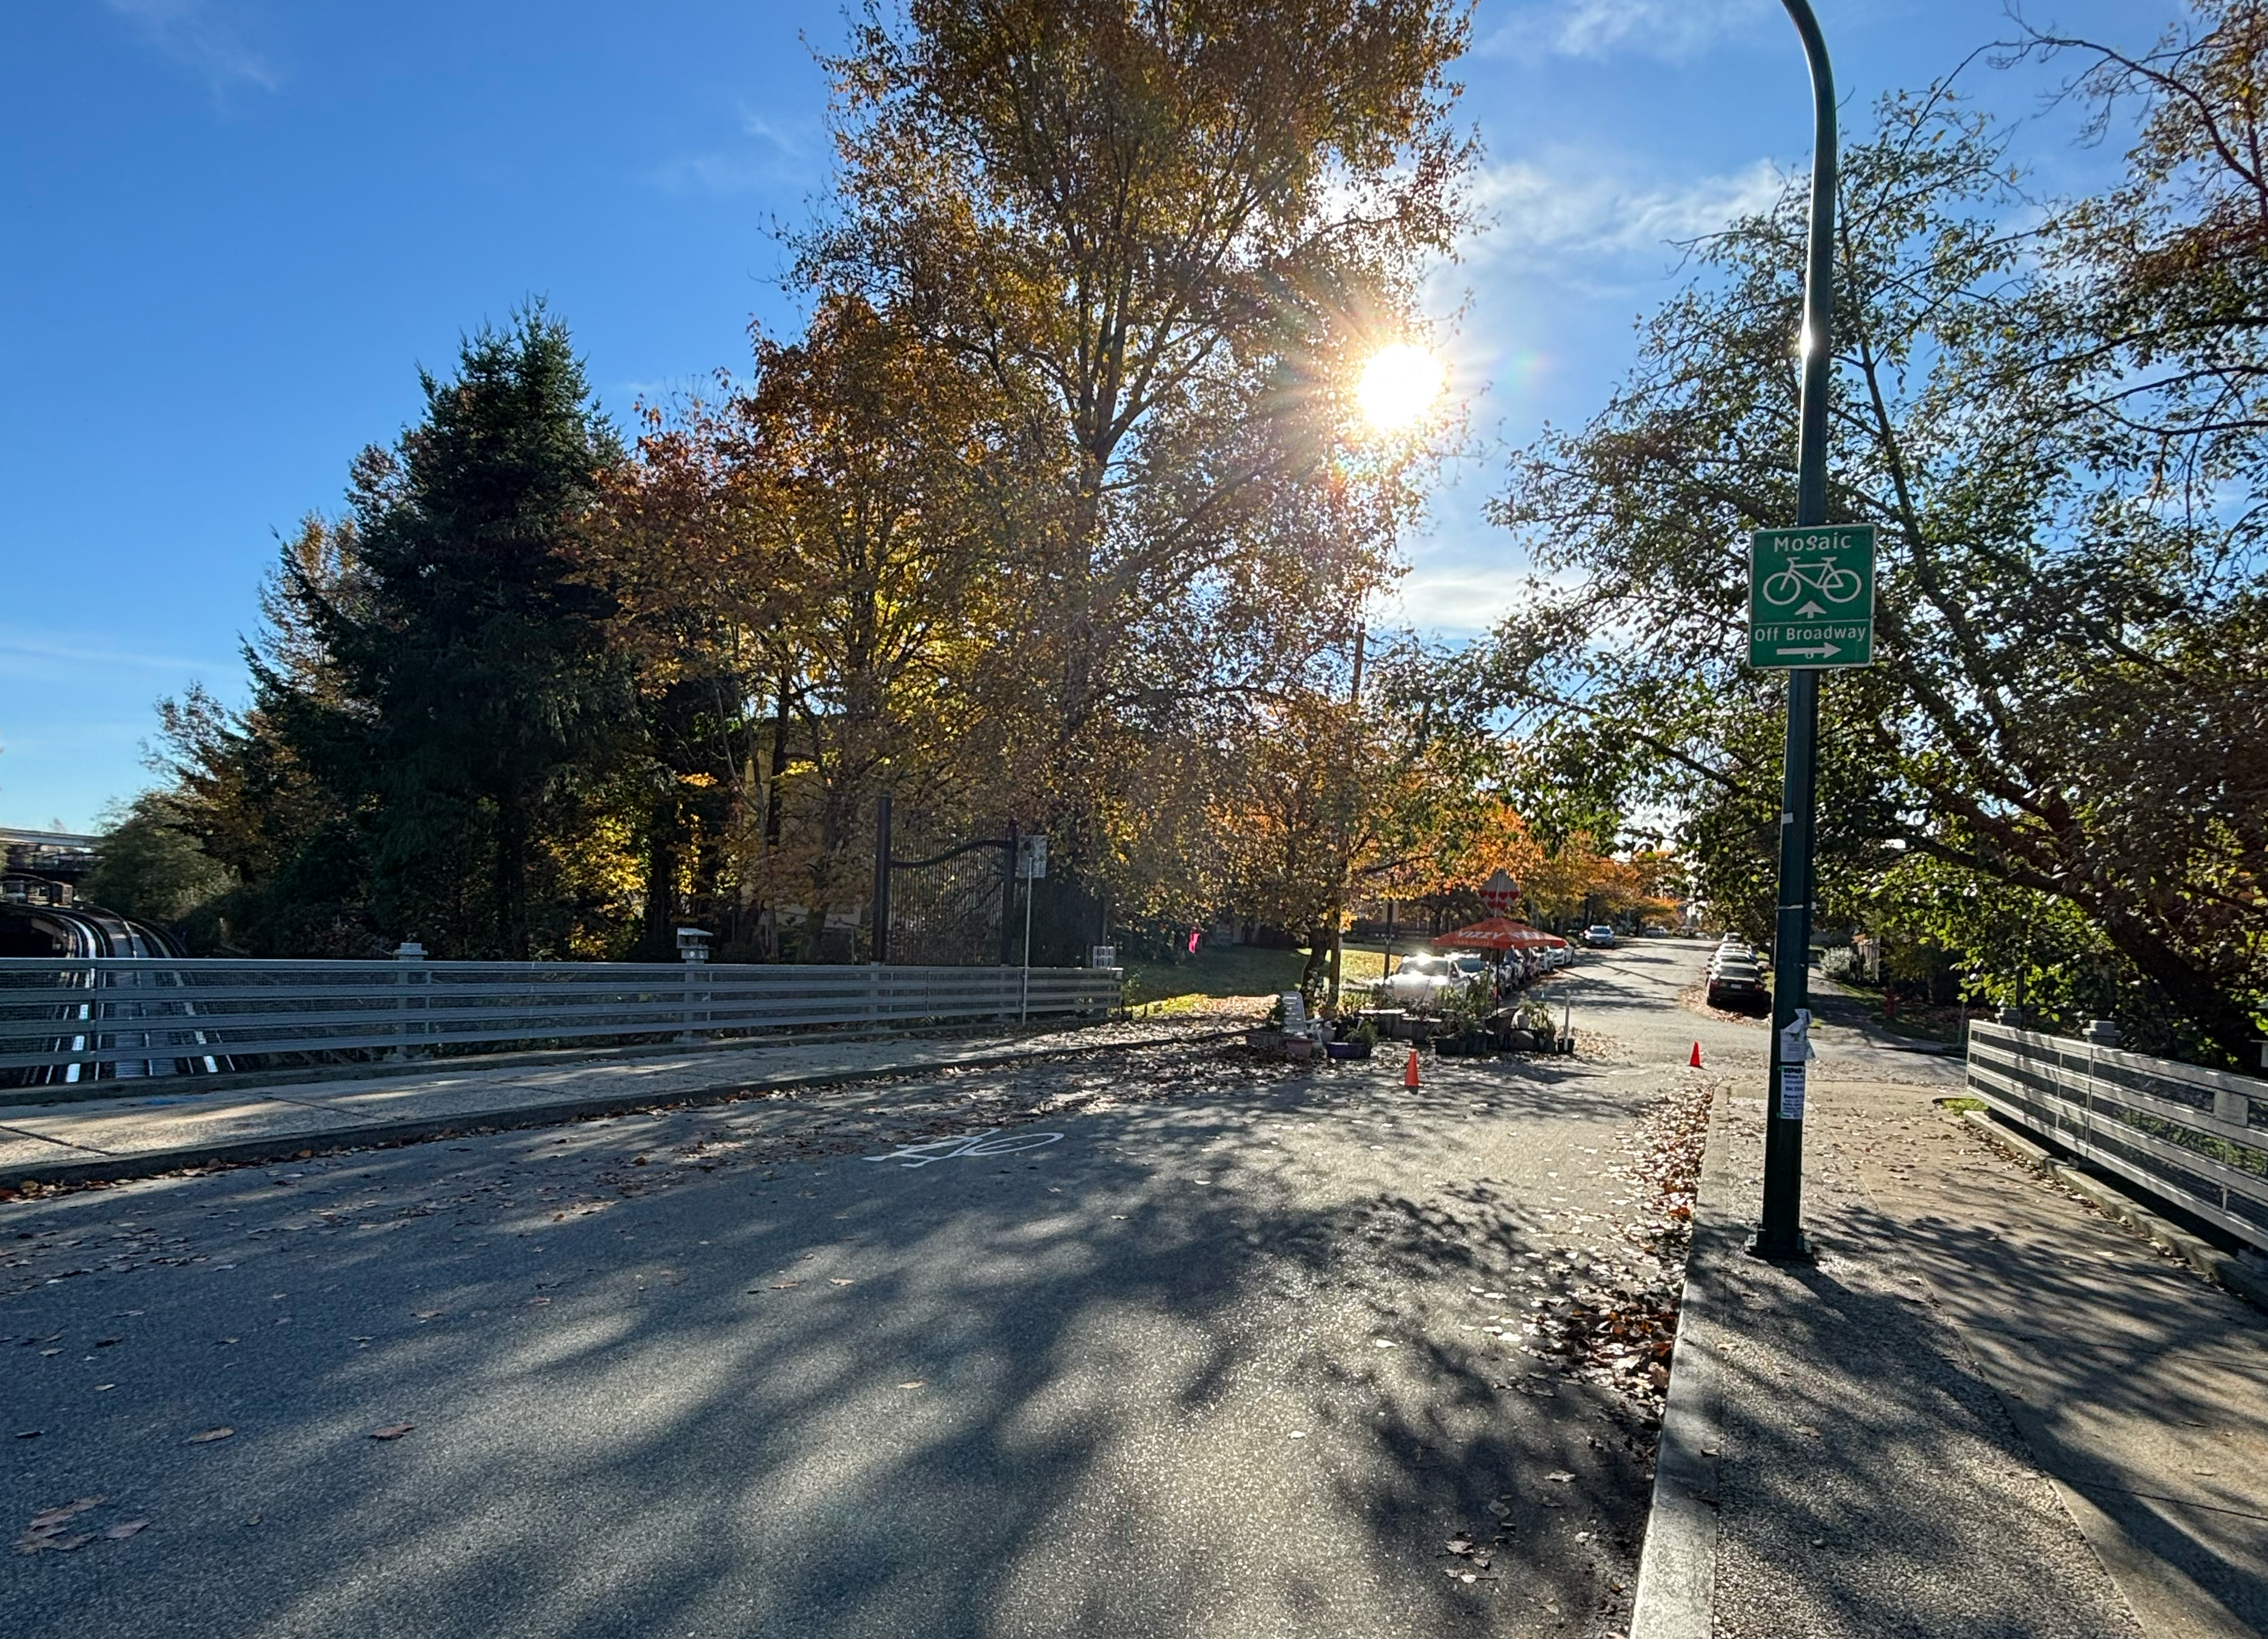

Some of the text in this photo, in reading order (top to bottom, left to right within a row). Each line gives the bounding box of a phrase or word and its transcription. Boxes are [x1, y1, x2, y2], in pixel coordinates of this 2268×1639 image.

[1774, 532, 1851, 552] Mosaic
[1755, 626, 1866, 641] Off Broadway
[1458, 930, 1505, 939] VIZZY
